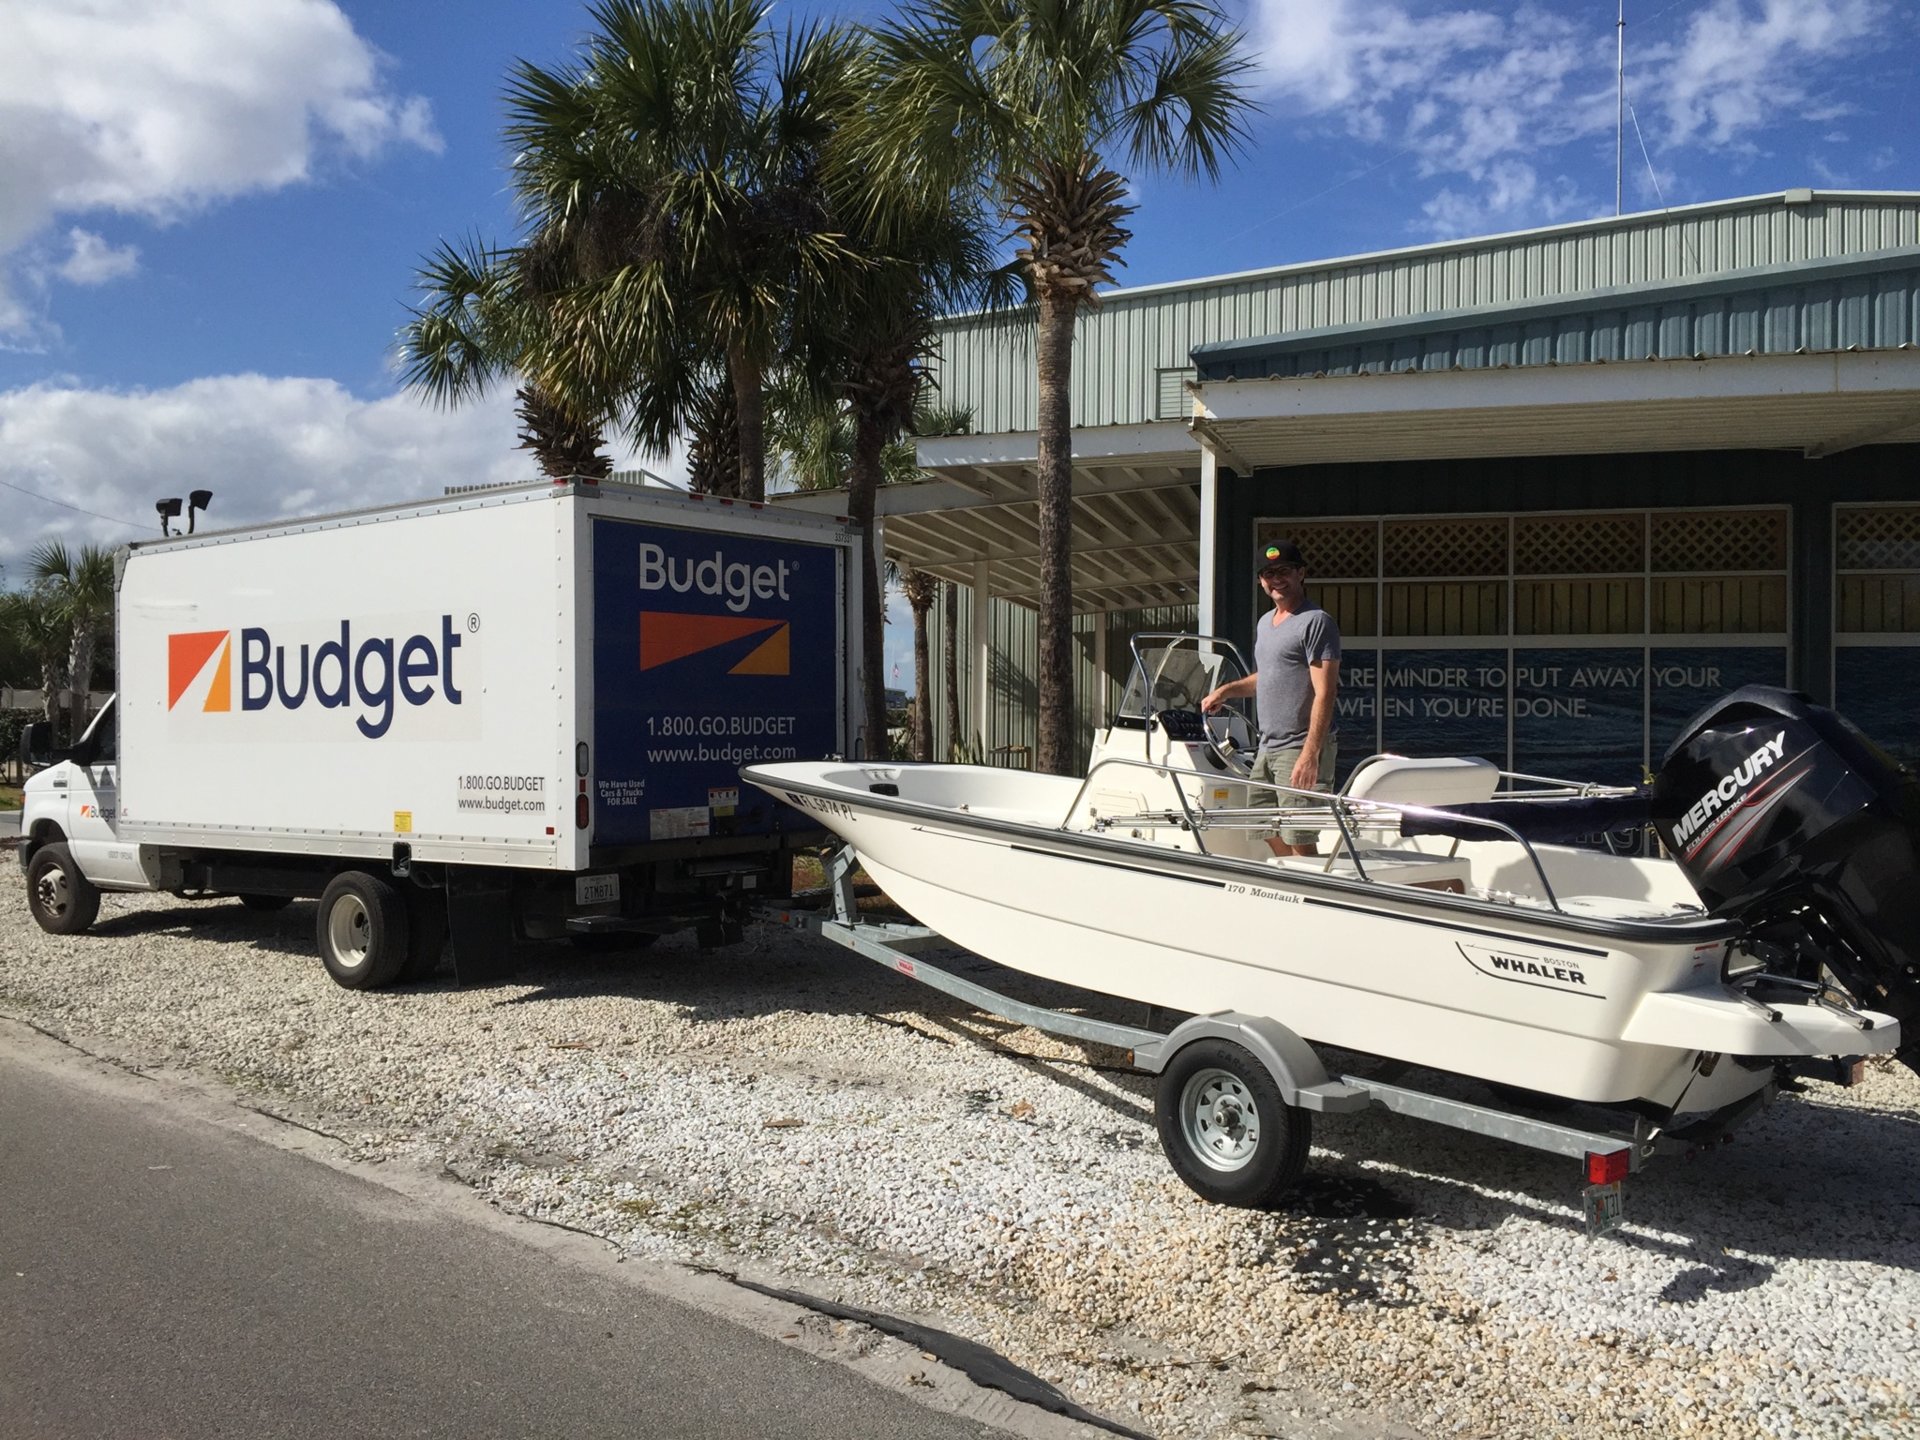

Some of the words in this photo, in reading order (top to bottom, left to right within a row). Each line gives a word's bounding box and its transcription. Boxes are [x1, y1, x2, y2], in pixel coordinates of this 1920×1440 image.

[1475, 667, 1507, 687] TO
[1516, 667, 1563, 687] PUT
[1569, 667, 1643, 687] AWAY
[1652, 667, 1722, 687] YOUR
[1420, 698, 1504, 717] YOU'RE
[1514, 698, 1592, 718] DONE.
[647, 716, 796, 736] 1.800.GO.BUDGET
[647, 742, 797, 765] www.budget.com
[457, 775, 545, 791] 1.800.GO.BUDGET
[598, 780, 610, 789] We
[611, 780, 628, 788] Have
[629, 779, 645, 788] Used
[600, 789, 616, 797] Cars
[616, 789, 621, 797] &
[622, 788, 644, 797] Trucks
[1672, 730, 1786, 848] MERCURY
[457, 795, 545, 813] www.budget.com
[607, 797, 621, 806] FOR
[621, 797, 637, 805] SALE
[799, 795, 817, 809] FL
[841, 803, 857, 821] PL
[1227, 884, 1246, 895] 170
[1250, 887, 1301, 904] Montauk
[1489, 955, 1588, 985] WHALER
[1543, 956, 1580, 969] BOSTON
